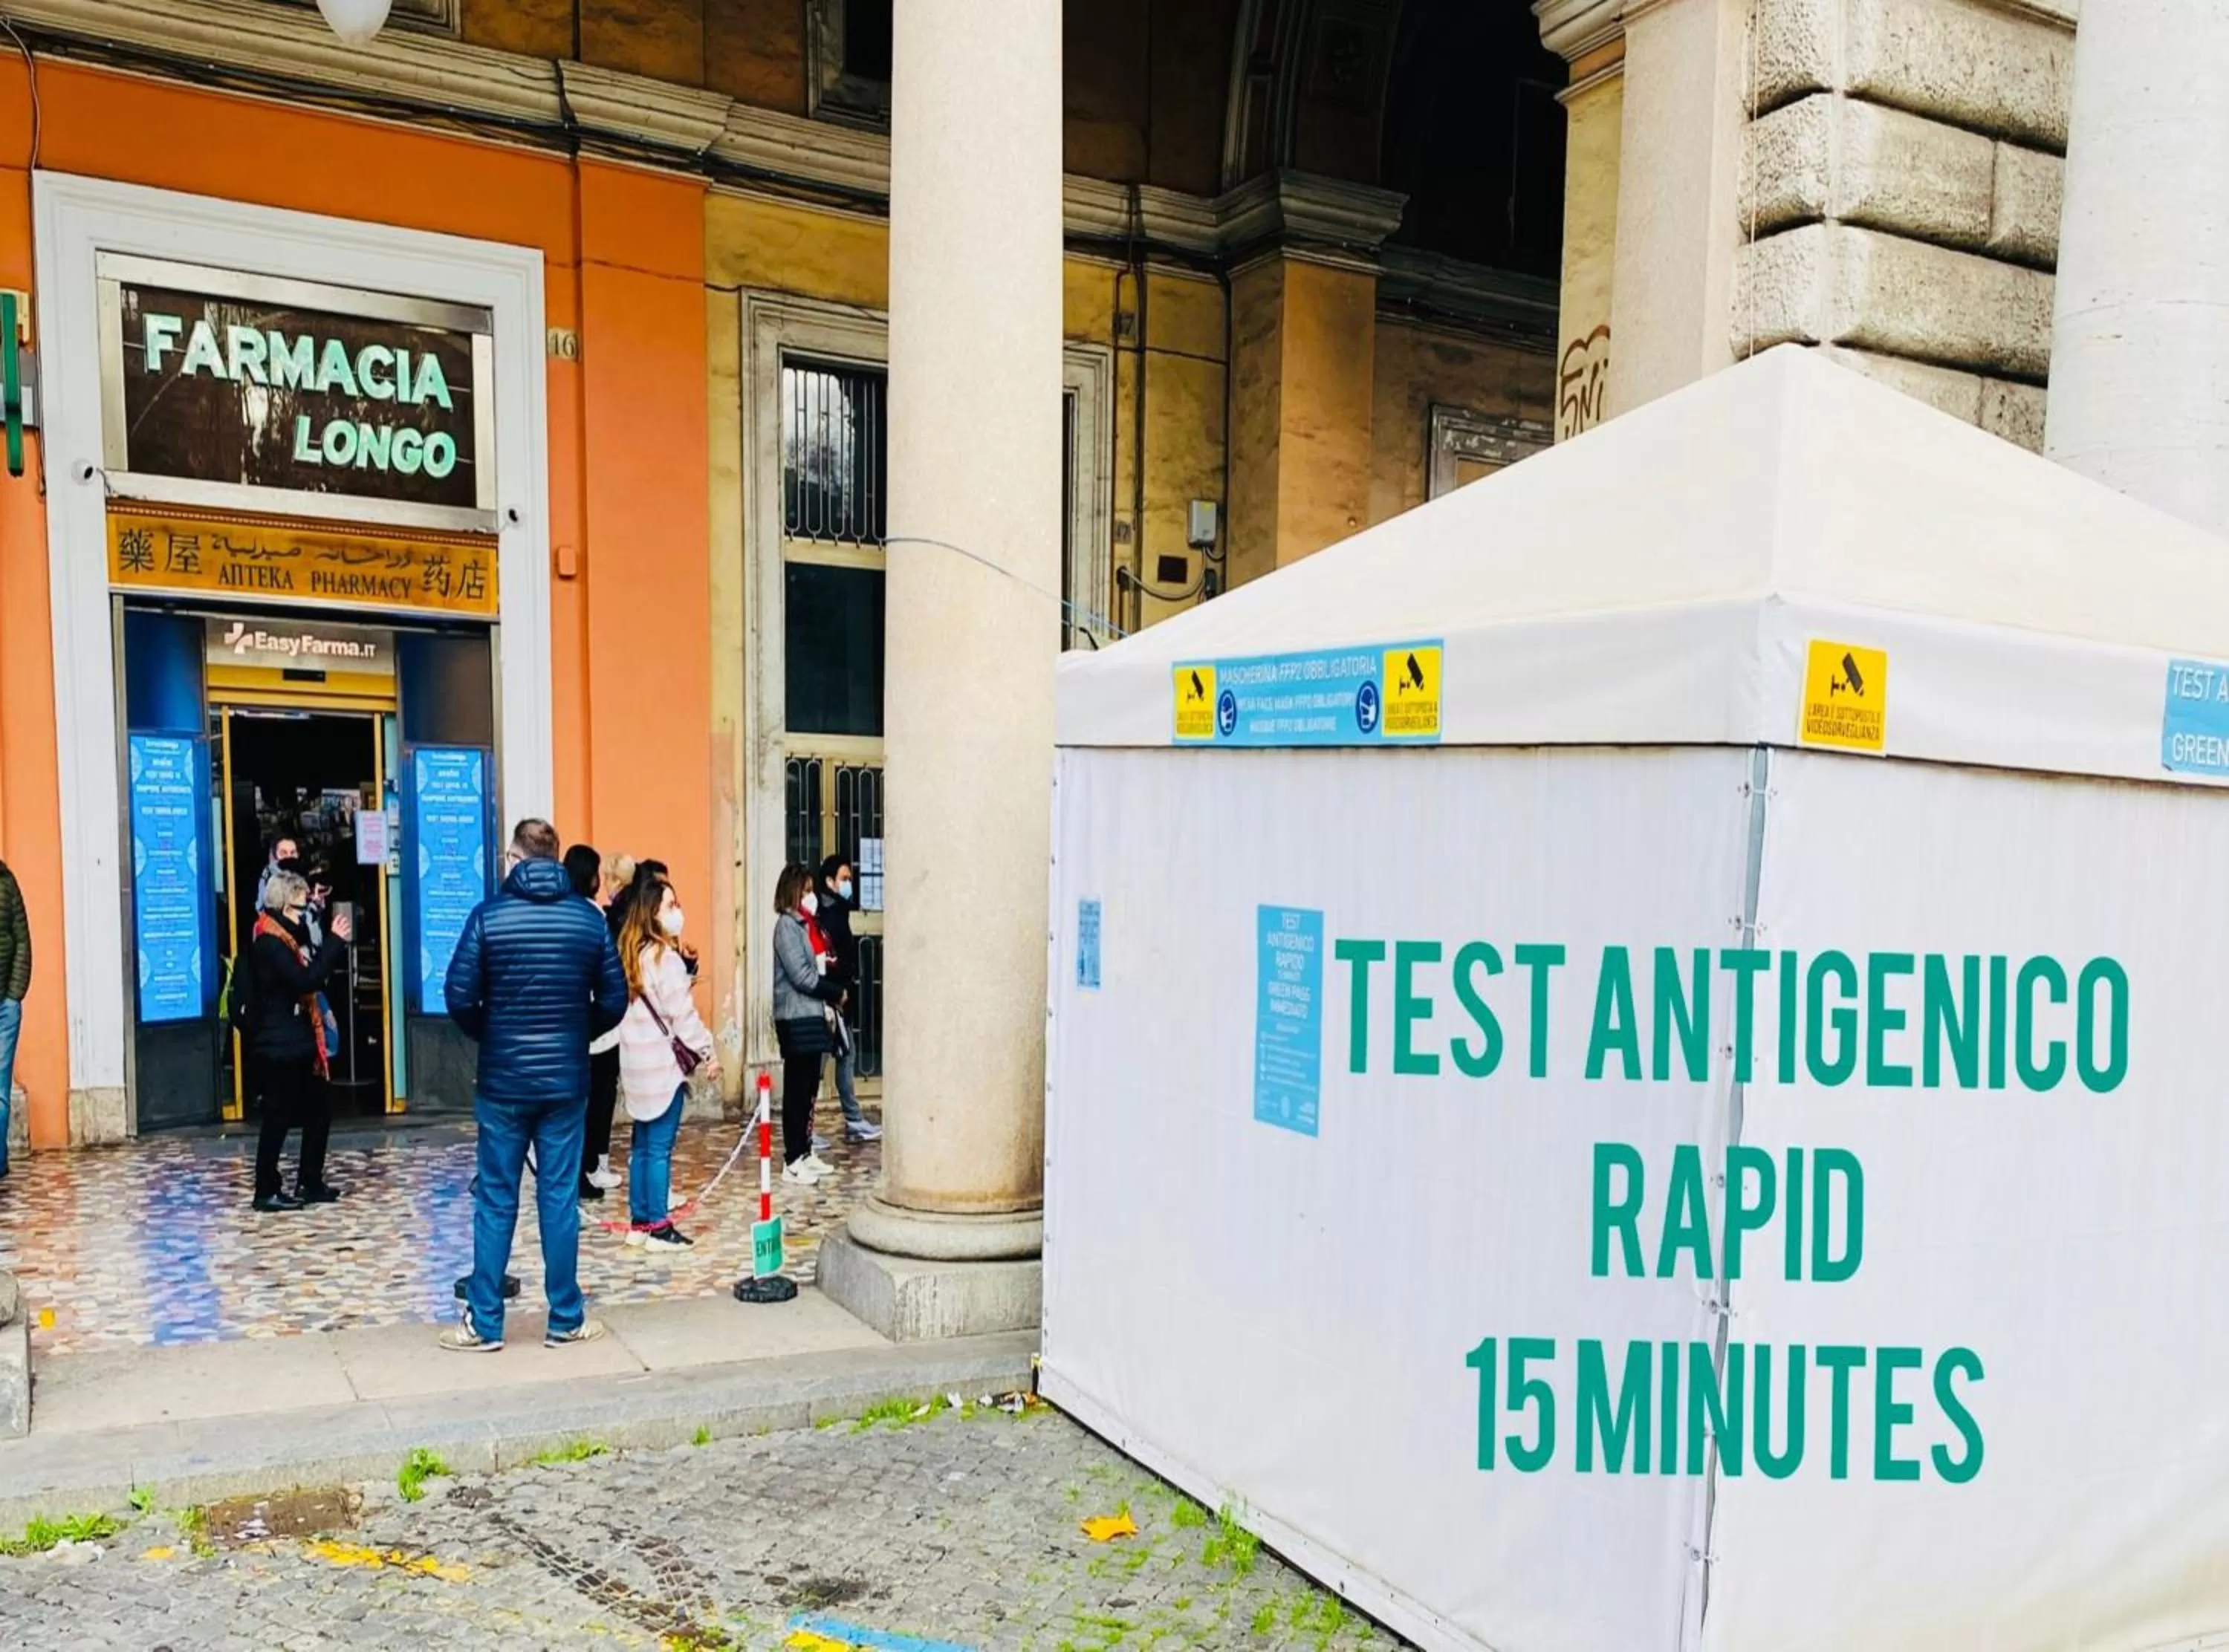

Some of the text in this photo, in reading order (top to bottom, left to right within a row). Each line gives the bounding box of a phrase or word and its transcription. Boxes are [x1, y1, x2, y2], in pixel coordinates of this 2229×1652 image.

[143, 312, 454, 412] FARMACIA
[550, 332, 575, 357] 16
[293, 414, 456, 478] LONGO
[119, 527, 203, 575] 藥屋
[311, 570, 412, 599] PHARMACY
[421, 554, 488, 599] 药店
[1219, 663, 1277, 686] MASCHERINA
[1304, 654, 1378, 680] OBBLIGATORIA
[2173, 666, 2215, 700] TEST
[2172, 732, 2229, 768] GREEN
